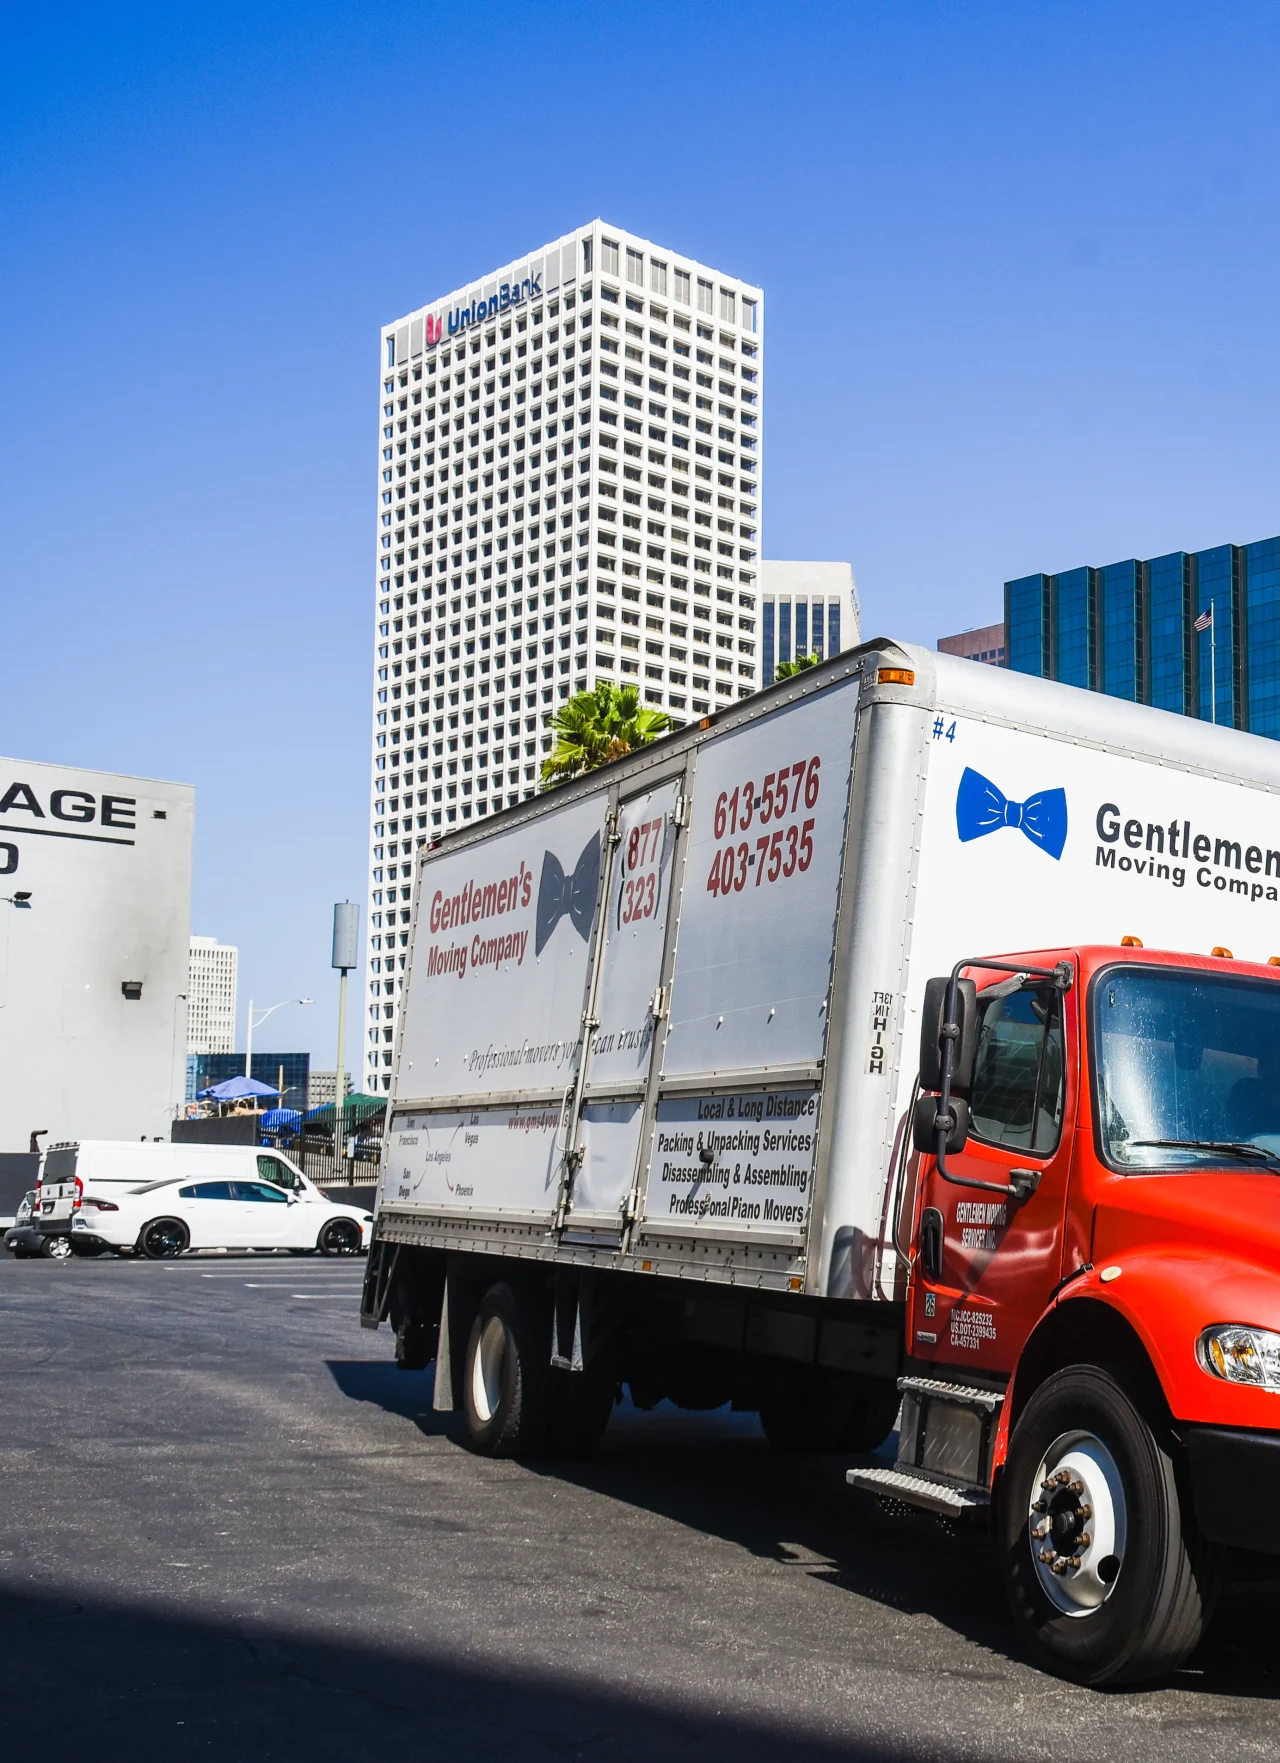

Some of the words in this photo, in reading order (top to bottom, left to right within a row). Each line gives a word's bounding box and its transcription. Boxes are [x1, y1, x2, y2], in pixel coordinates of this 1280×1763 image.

[932, 715, 957, 743] #4
[0, 781, 137, 830] AGE
[620, 812, 668, 878] (877)
[713, 755, 821, 840] 613-5576
[616, 866, 662, 931] (323)
[706, 817, 816, 898] 403-7535
[1095, 846, 1186, 887] Moving
[429, 860, 533, 934] Gentlemen's
[426, 942, 468, 979] Moving
[470, 929, 529, 970] Company
[467, 1039, 528, 1078] Professional
[525, 1043, 560, 1064] movers
[594, 1033, 616, 1055] can
[406, 1116, 416, 1128] San
[470, 1112, 480, 1125] Las
[697, 1098, 725, 1120] Local
[727, 1097, 735, 1118] &
[737, 1097, 764, 1122] Long
[766, 1095, 815, 1117] Distance
[398, 1133, 419, 1146] Francisco
[465, 1132, 480, 1148] Vegas
[657, 1132, 694, 1157] Packing
[696, 1131, 704, 1151] &
[707, 1129, 760, 1156] Unpacking
[763, 1129, 812, 1151] Services
[425, 1151, 434, 1162] Los
[434, 1151, 451, 1165] Angeles
[402, 1168, 411, 1179] San
[661, 1162, 731, 1189] Disassembling
[733, 1163, 741, 1184] &
[743, 1164, 808, 1193] Assembling
[398, 1185, 411, 1200] Diego
[455, 1183, 475, 1196] Phoenix
[669, 1194, 731, 1217] Professonal
[731, 1197, 760, 1220] Piano
[763, 1198, 804, 1223] Movers
[956, 1201, 987, 1224] GENTLEMEN
[986, 1203, 1007, 1226] MOVING
[961, 1227, 986, 1249] SERVICES
